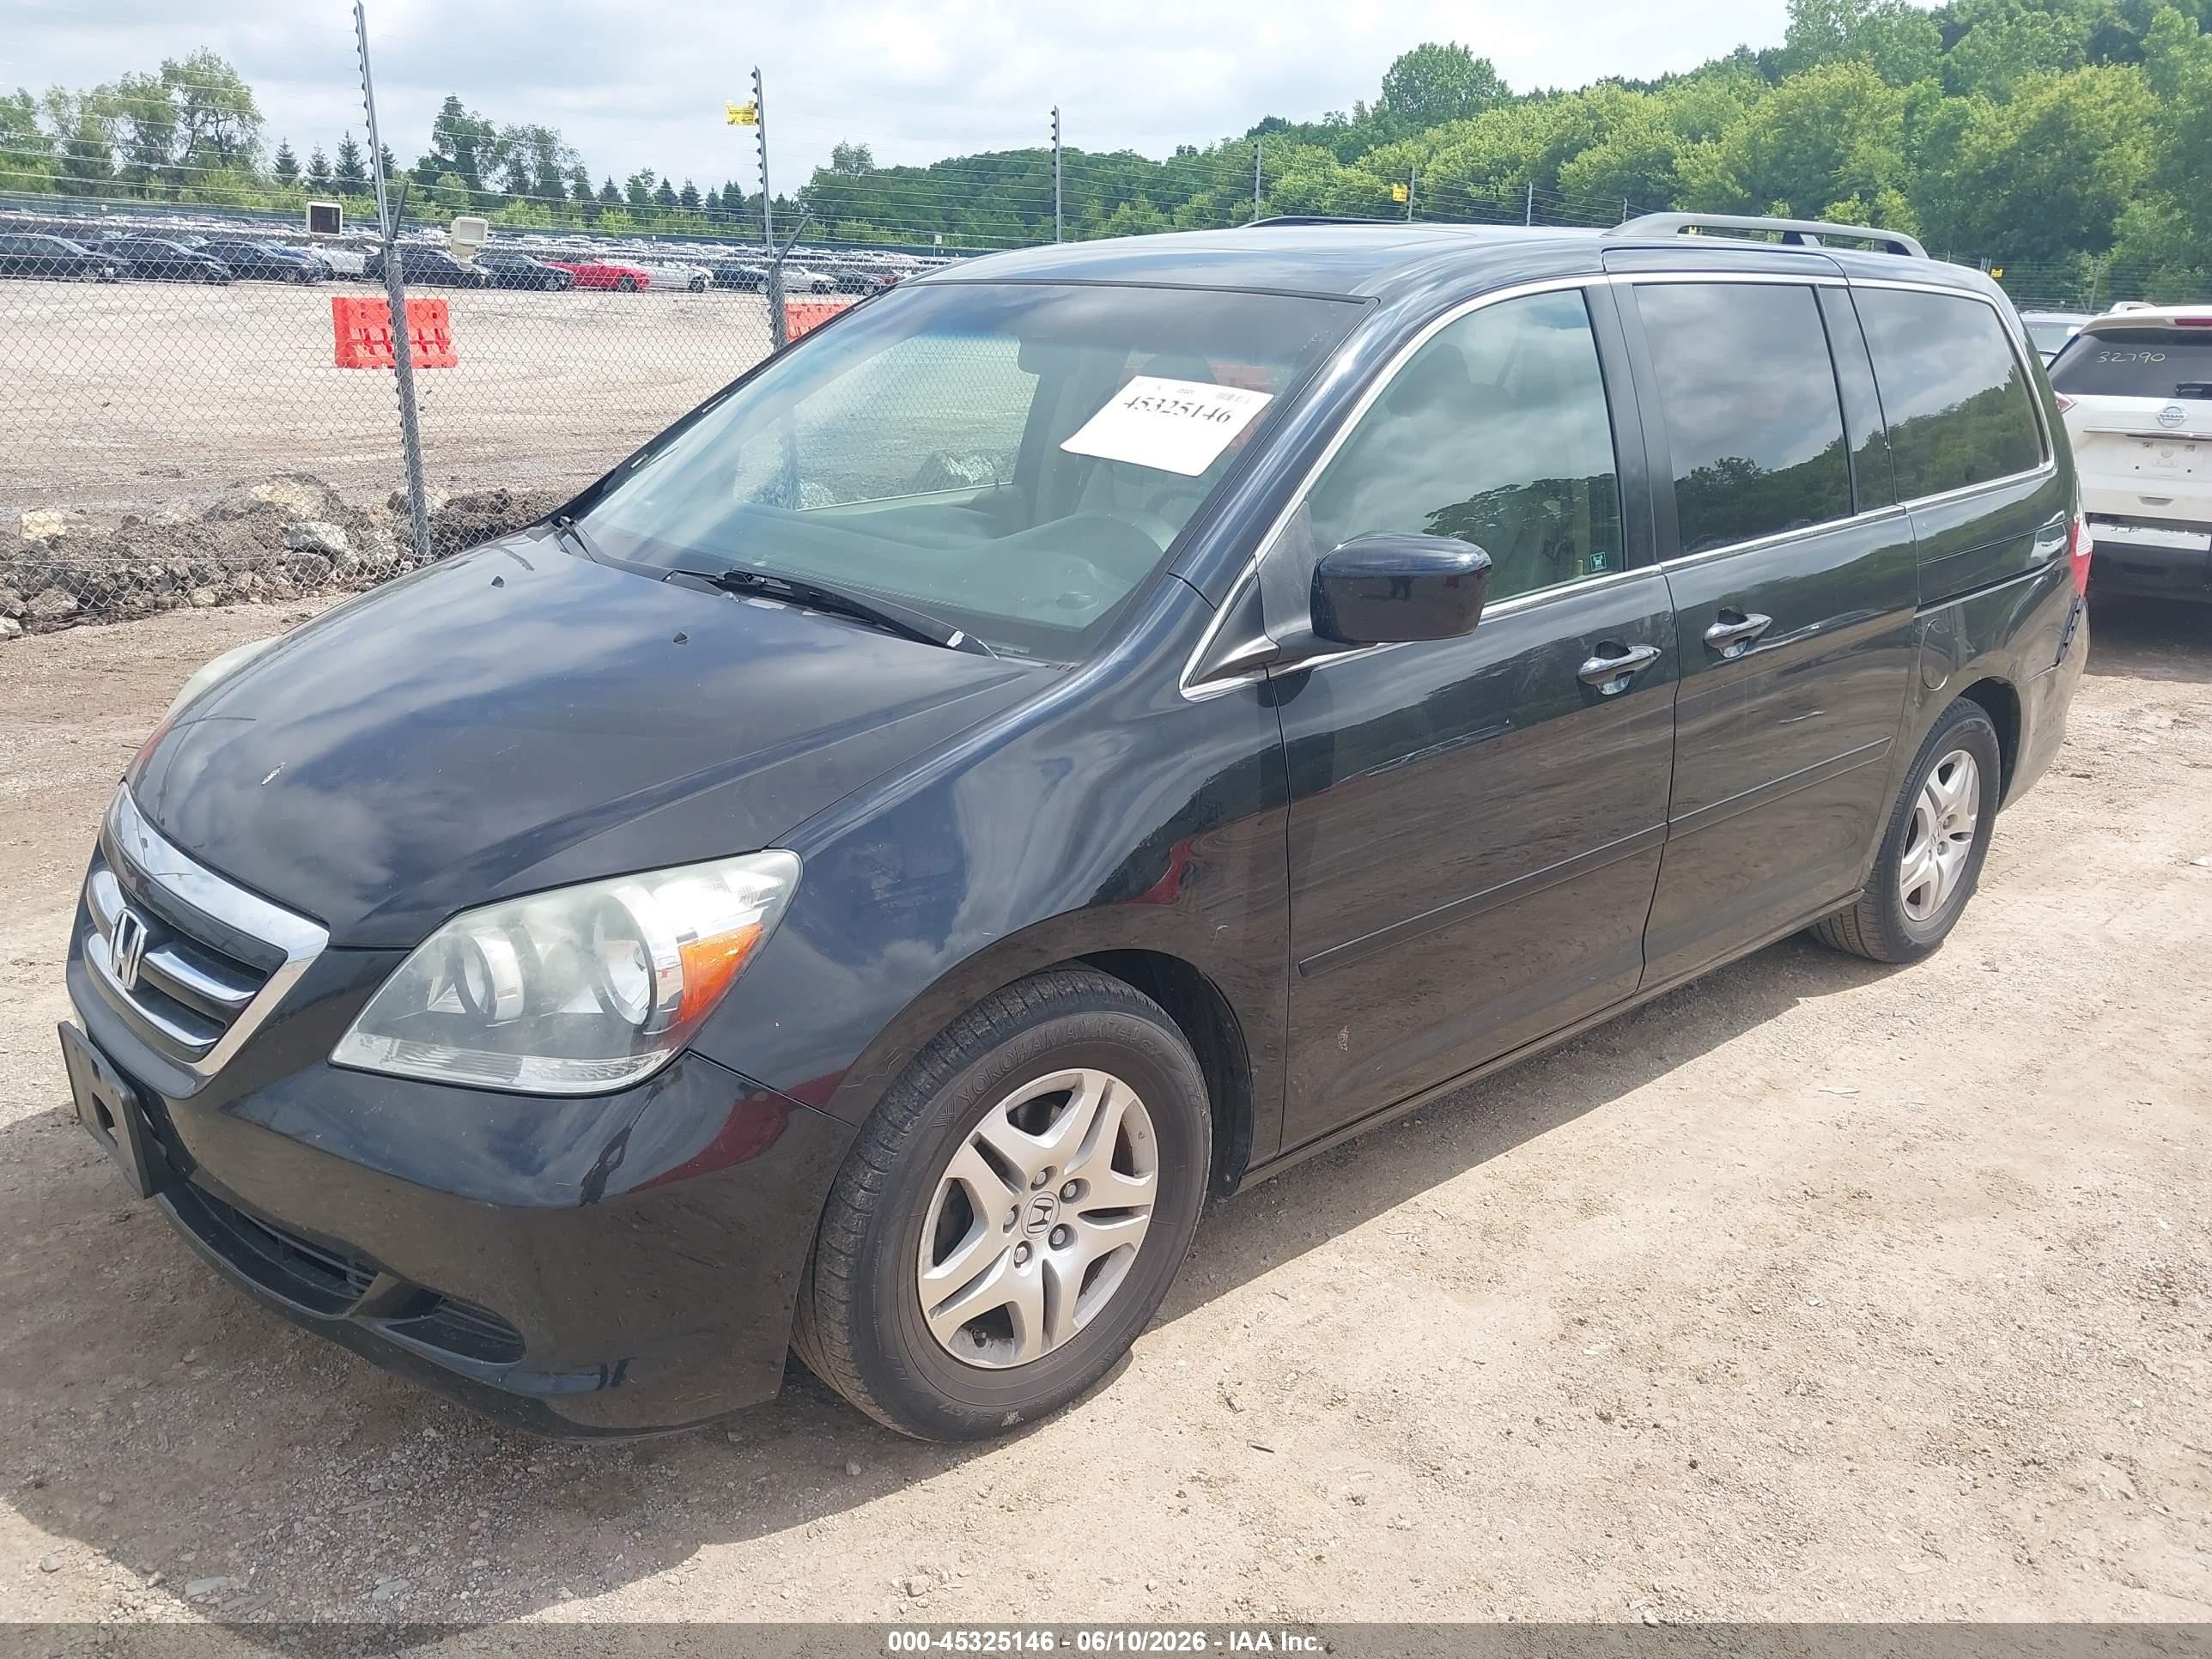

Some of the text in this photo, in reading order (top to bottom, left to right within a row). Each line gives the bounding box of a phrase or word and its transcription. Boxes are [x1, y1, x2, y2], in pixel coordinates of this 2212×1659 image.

[2095, 350, 2166, 364] 32790
[1122, 394, 1235, 424] 45325146
[958, 1021, 1079, 1105] YOKOHAMA
